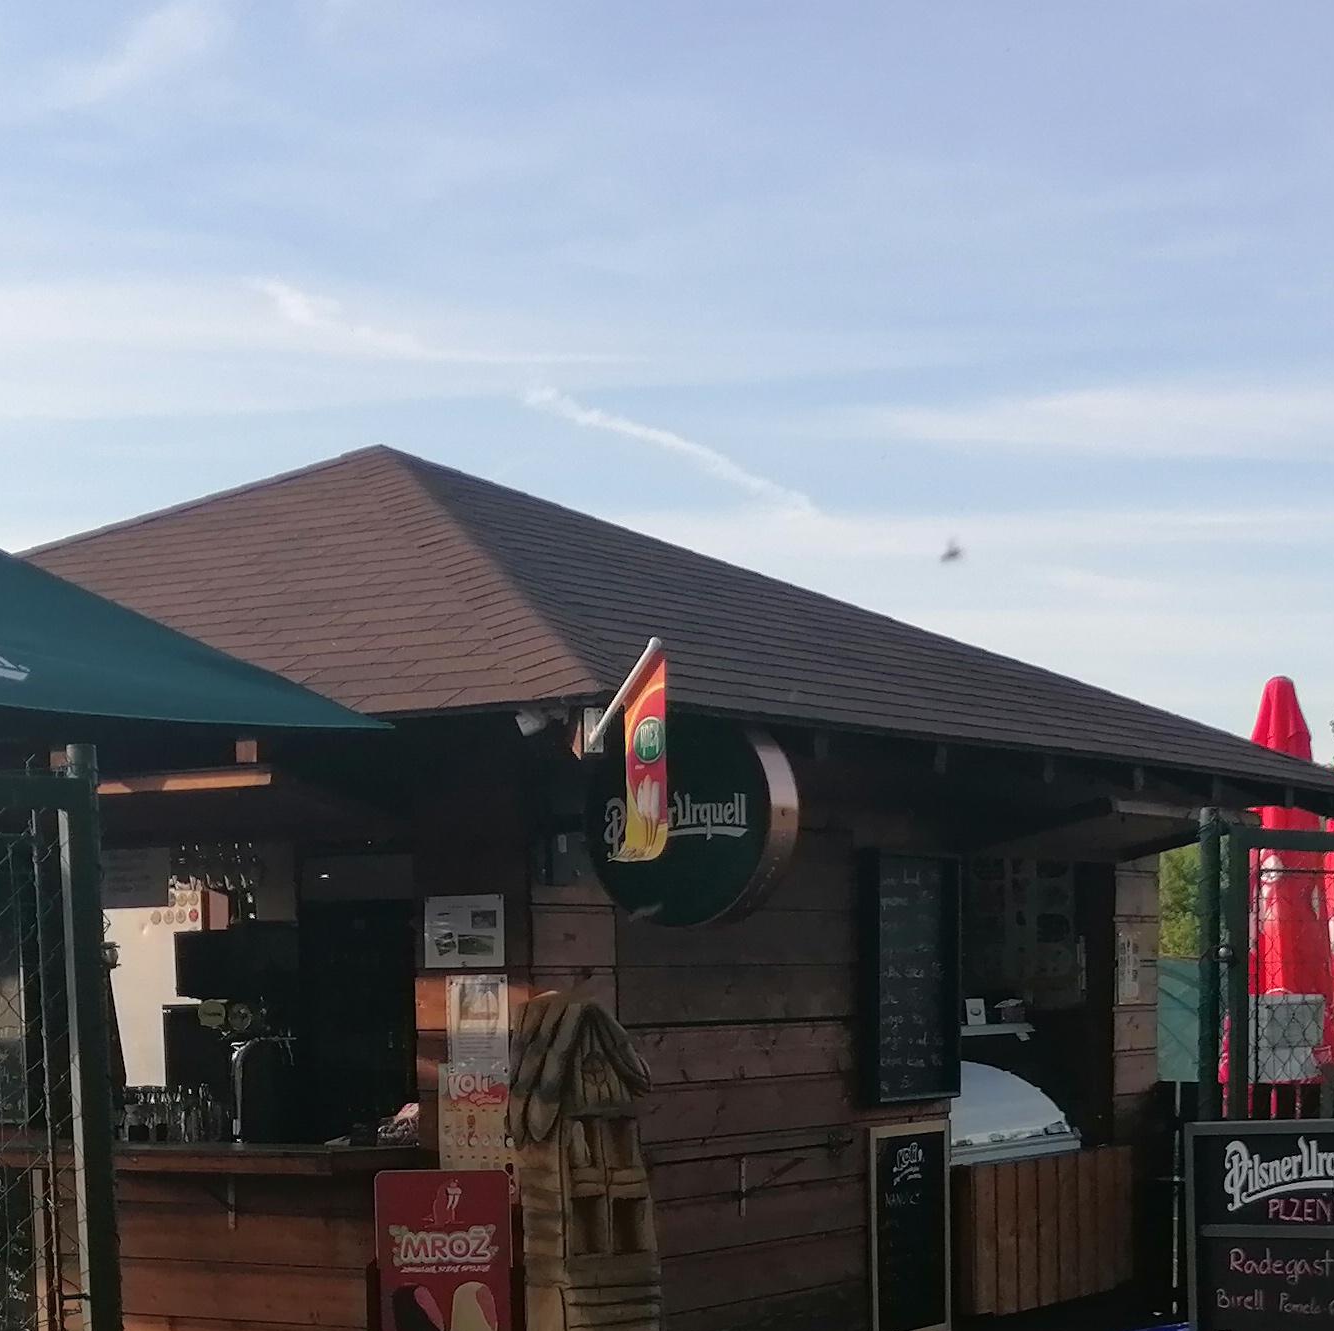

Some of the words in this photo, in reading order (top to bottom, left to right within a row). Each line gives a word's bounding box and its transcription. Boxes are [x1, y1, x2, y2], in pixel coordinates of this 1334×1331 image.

[672, 791, 747, 840] Urquell
[1224, 1140, 1301, 1212] Pilsner
[401, 1226, 491, 1264] MROŽ
[1228, 1246, 1334, 1284] Radegast
